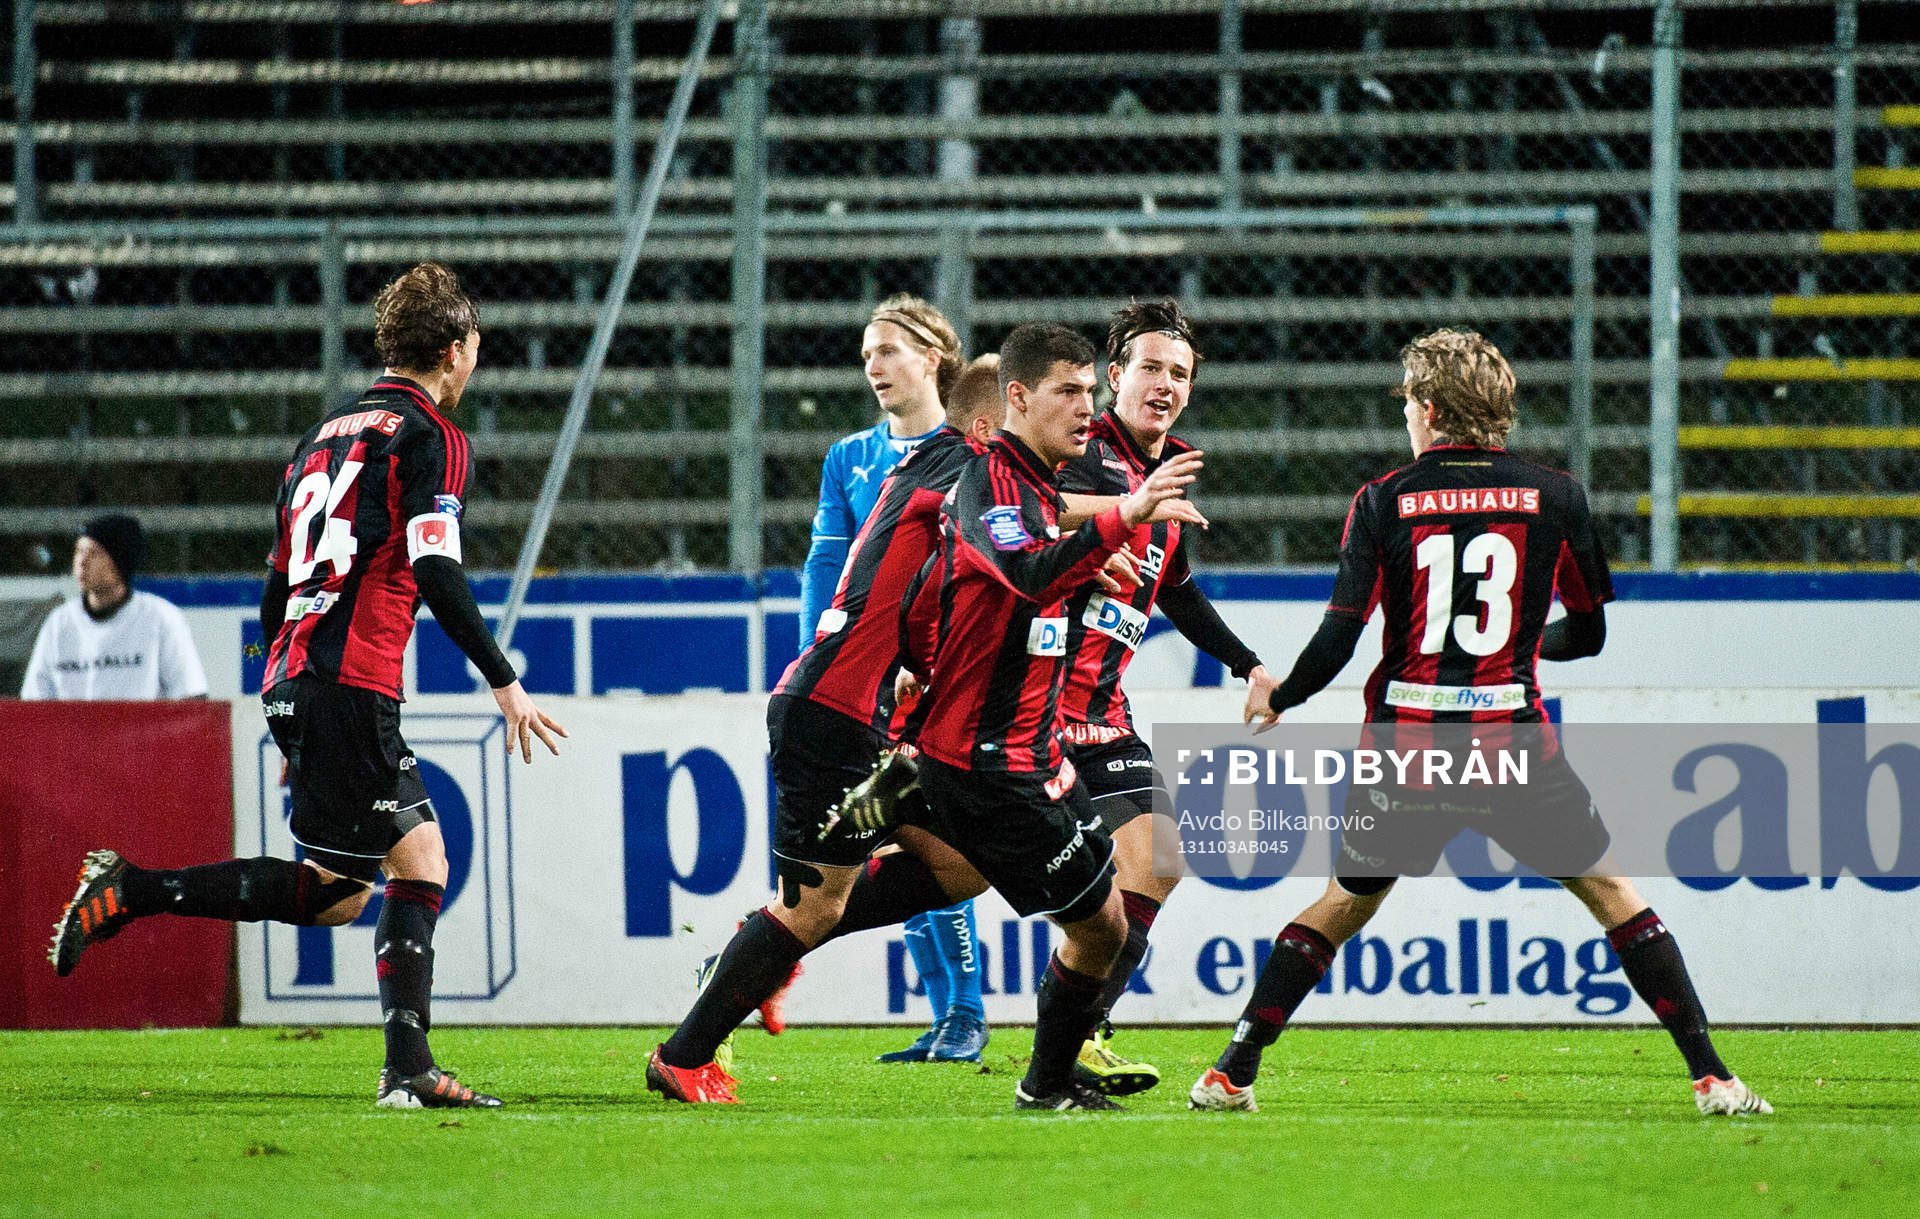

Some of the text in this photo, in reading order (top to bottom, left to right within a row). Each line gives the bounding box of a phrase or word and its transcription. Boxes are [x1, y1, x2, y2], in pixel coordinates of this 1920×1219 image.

[288, 460, 358, 587] 24
[1401, 489, 1539, 516] BAUHAUS
[1416, 532, 1518, 656] 13
